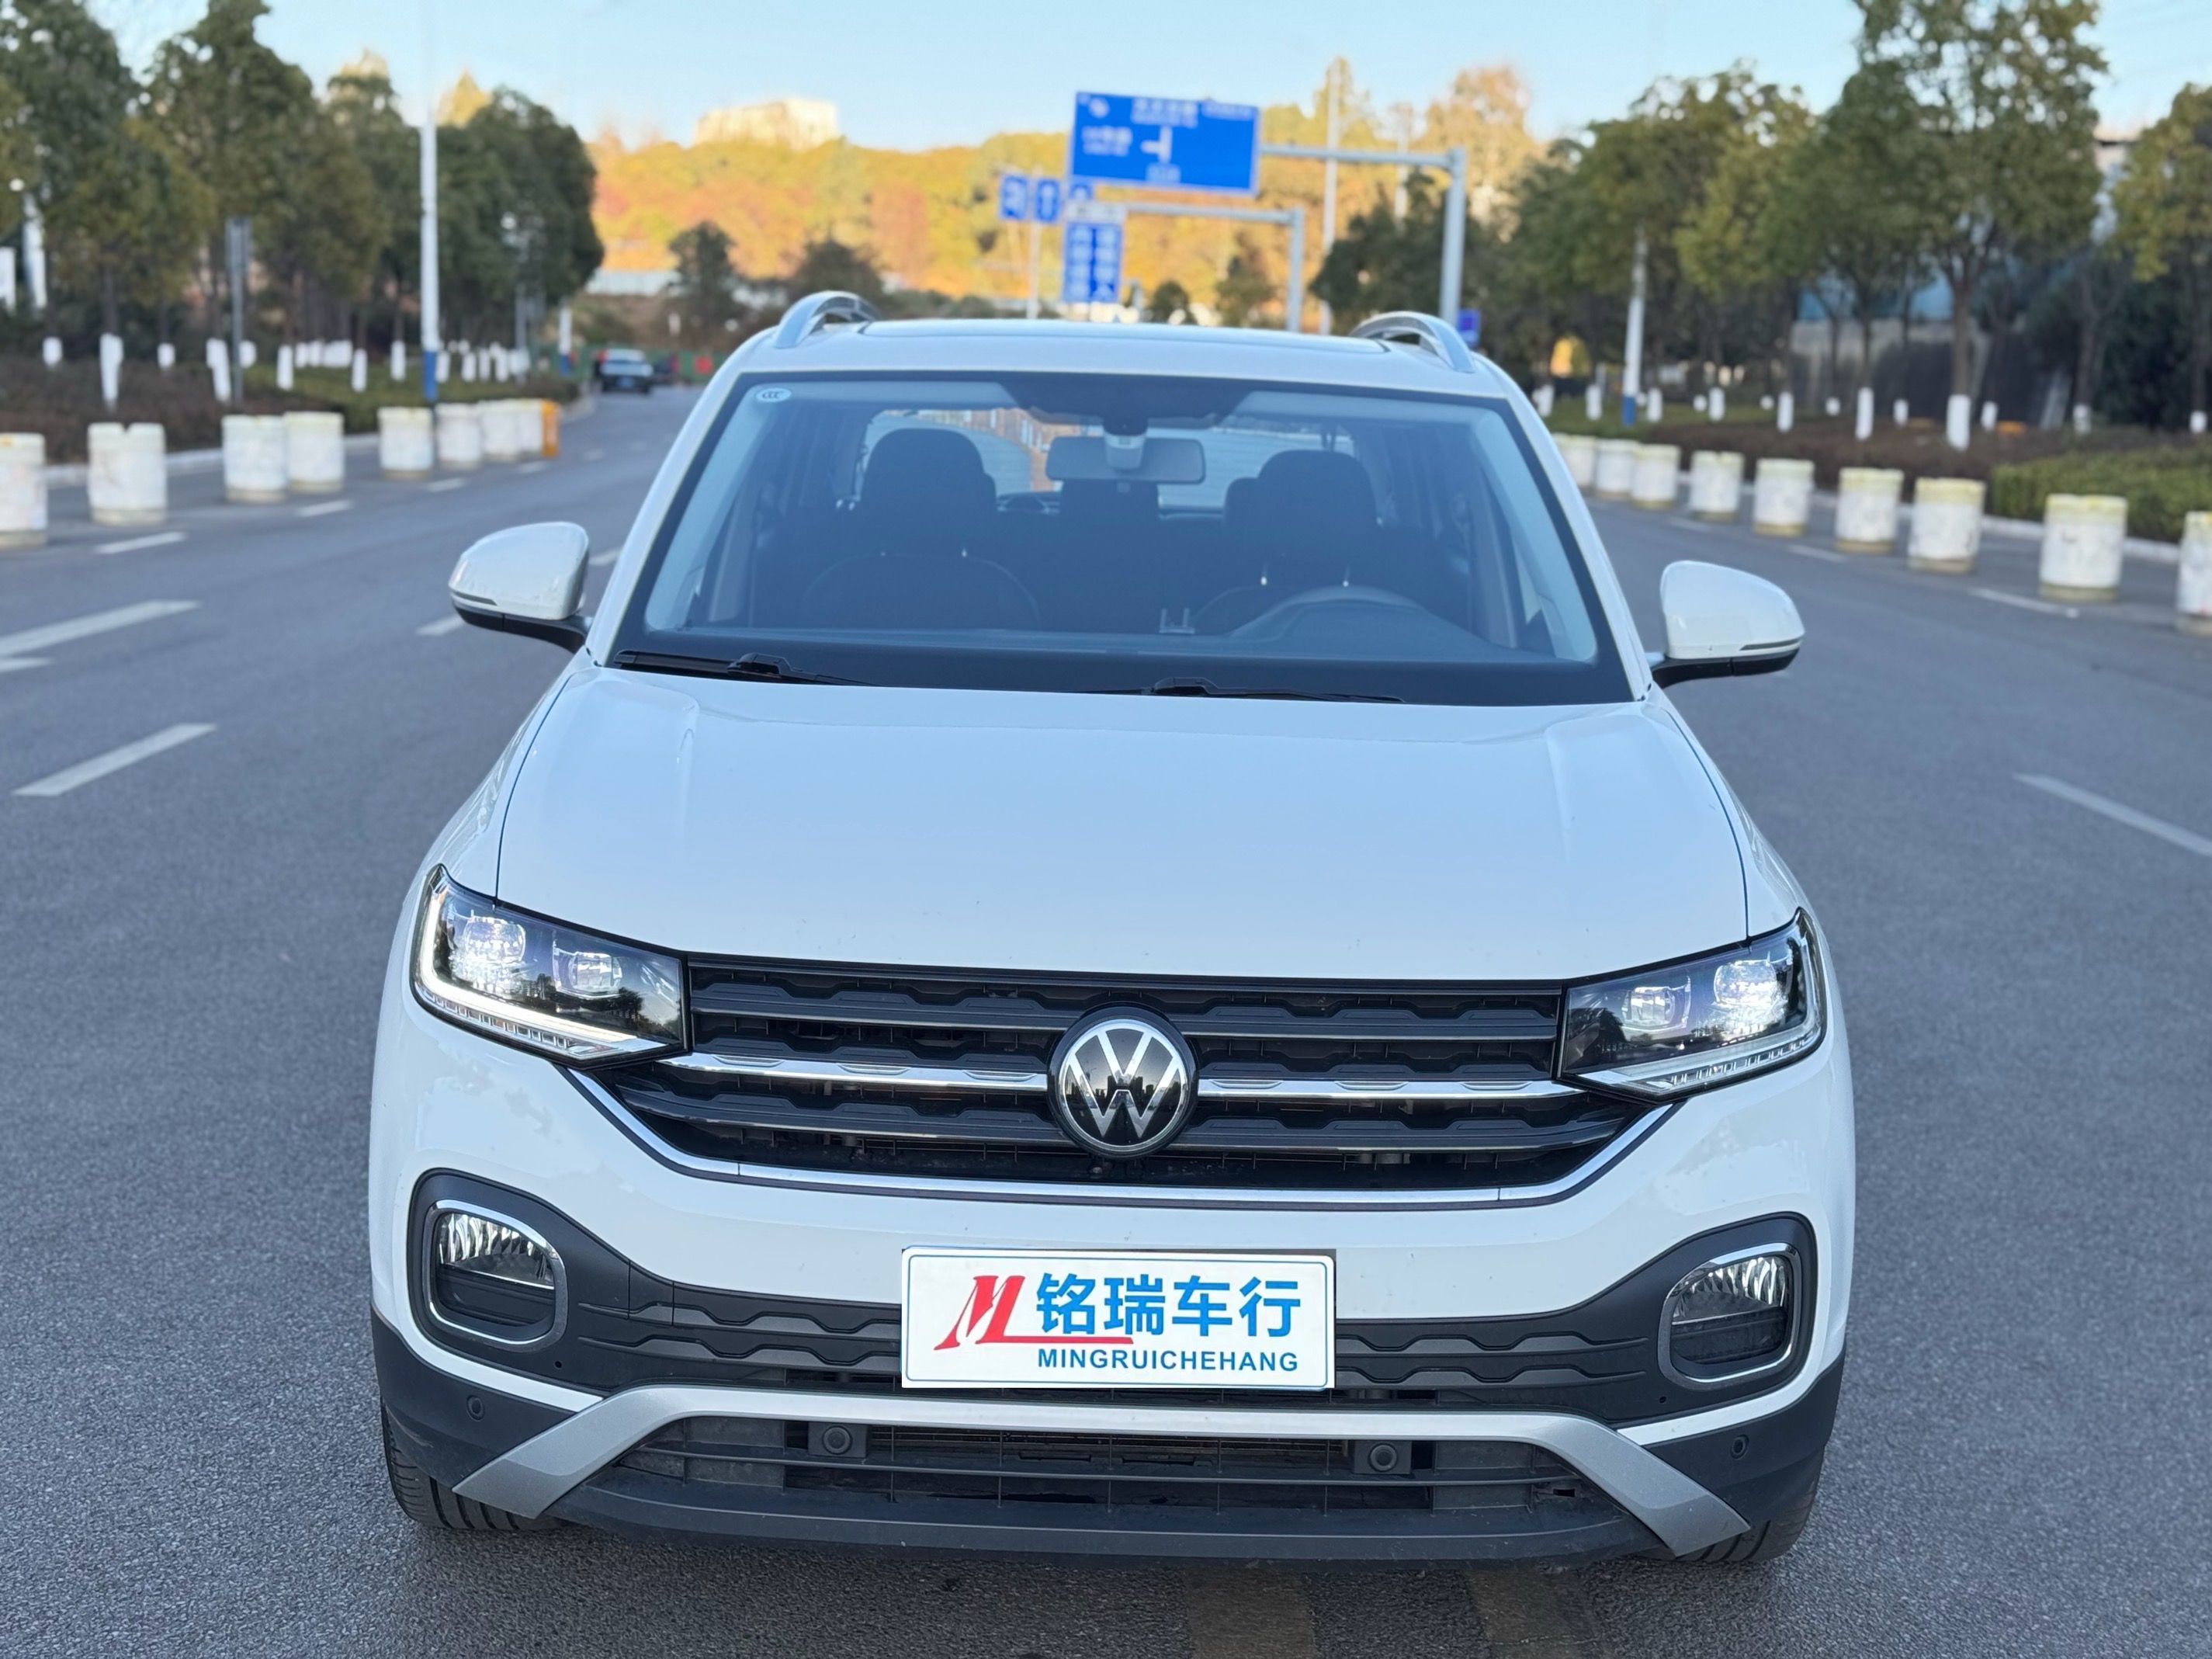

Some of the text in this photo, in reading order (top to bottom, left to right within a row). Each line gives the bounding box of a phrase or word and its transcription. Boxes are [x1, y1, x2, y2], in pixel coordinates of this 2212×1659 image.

[1063, 1026, 1183, 1139] VW
[1036, 1272, 1301, 1338] 铭瑞车行
[1038, 1348, 1298, 1372] MINGRUICHEHANG
